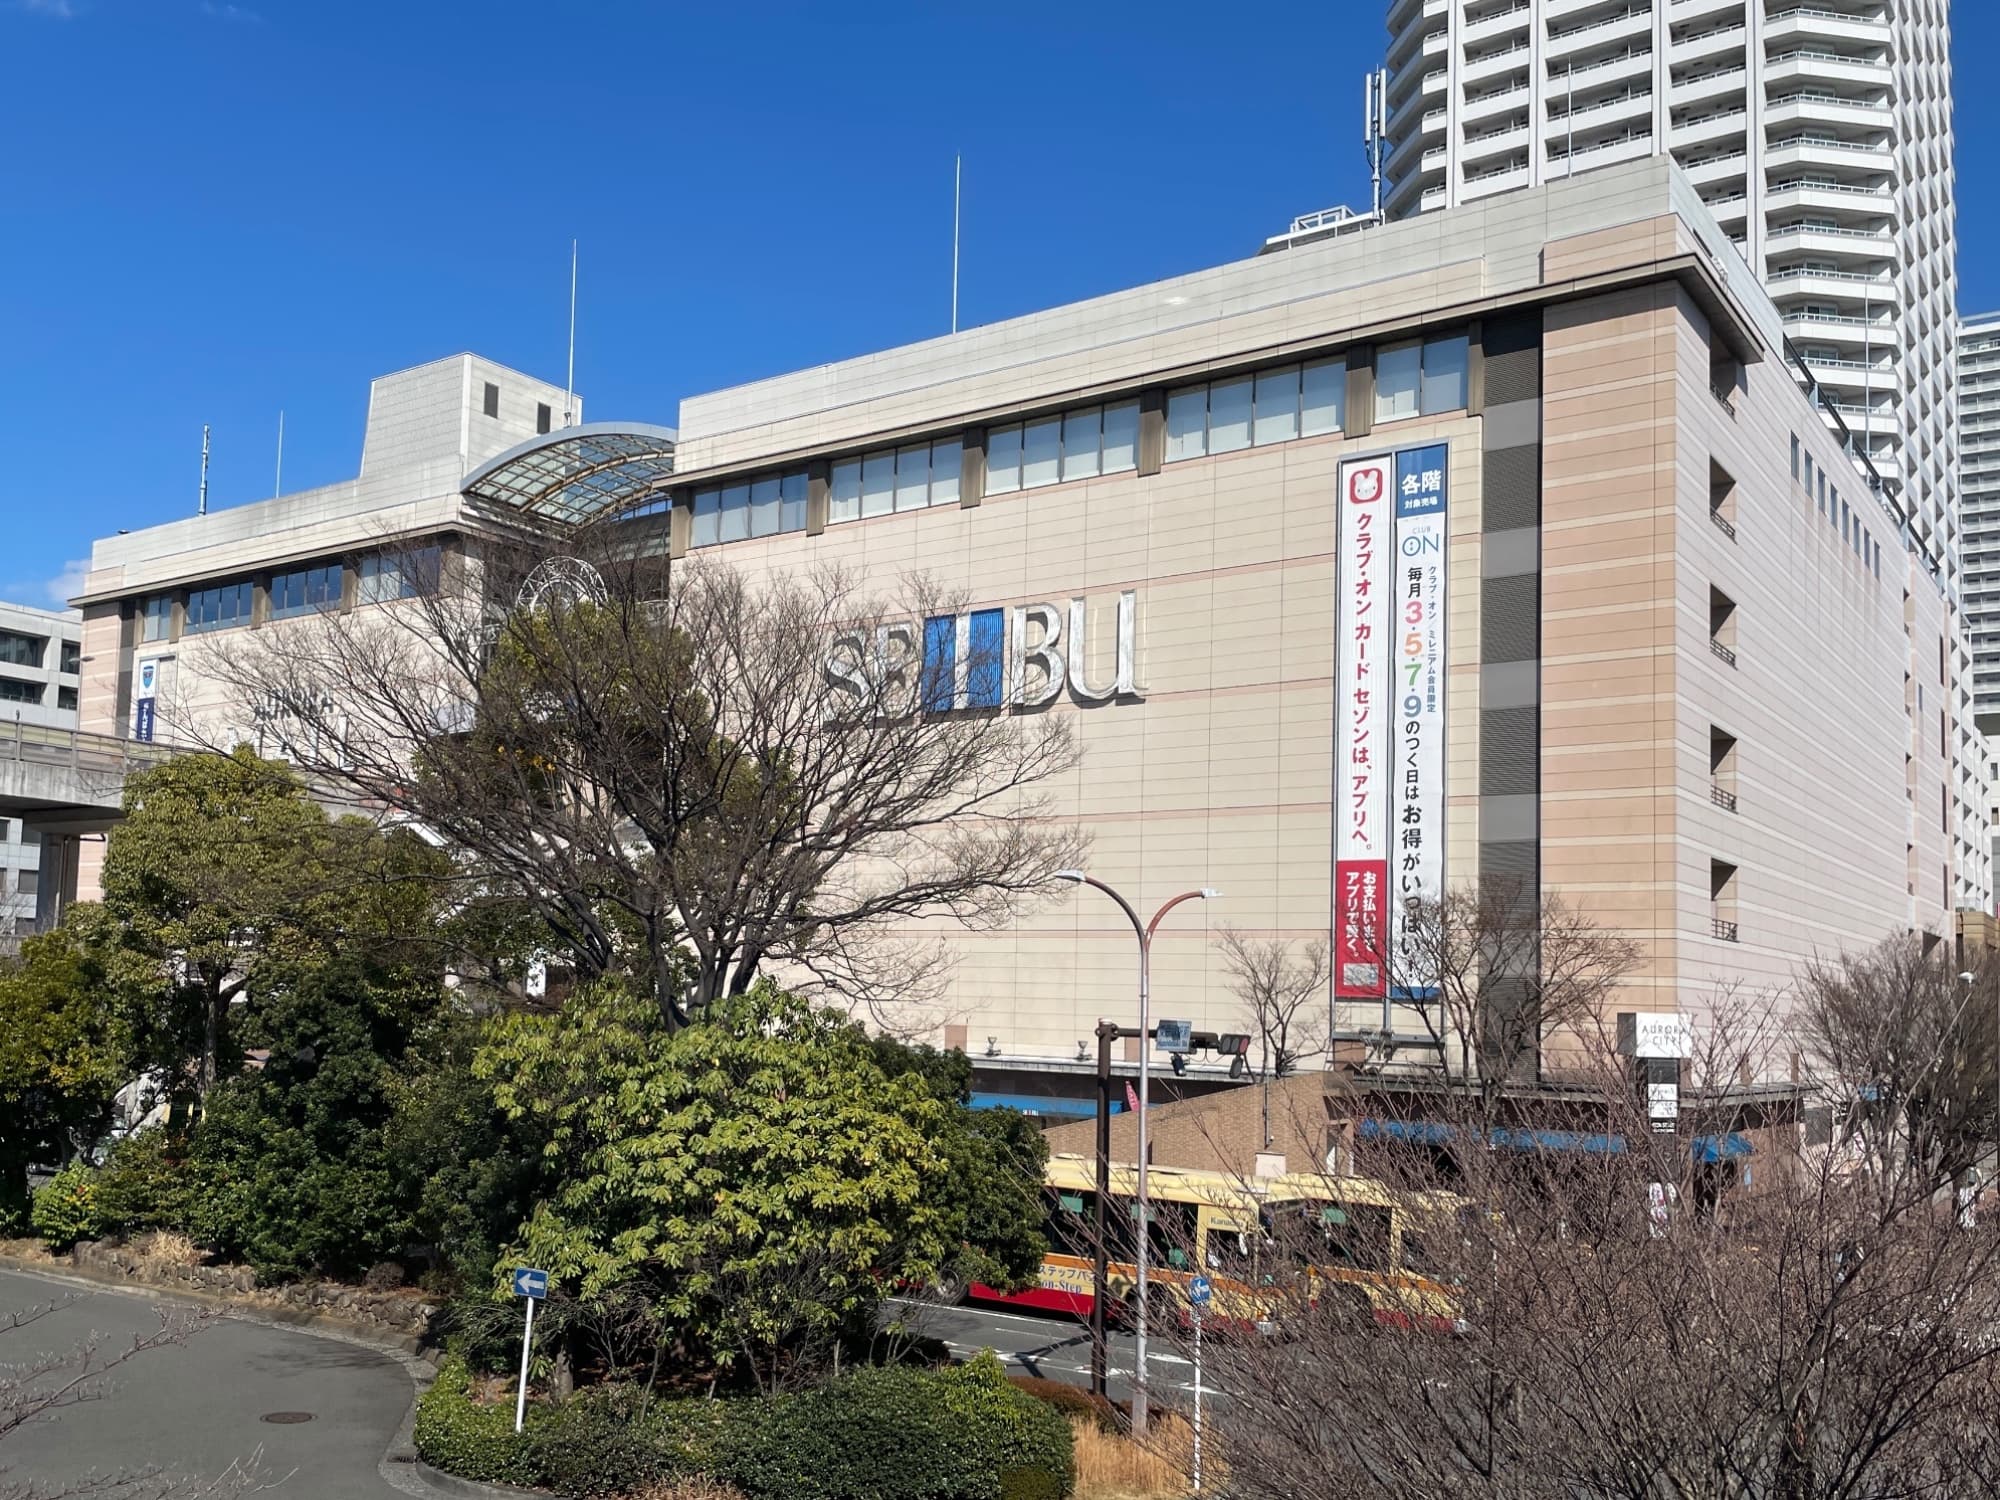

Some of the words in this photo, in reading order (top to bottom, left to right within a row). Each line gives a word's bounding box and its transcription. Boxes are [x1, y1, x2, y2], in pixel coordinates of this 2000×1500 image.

[1401, 469, 1442, 496] 各階
[1404, 496, 1439, 510] 対象売場
[1412, 526, 1431, 535] CLUB
[823, 589, 1149, 719] SEIBU
